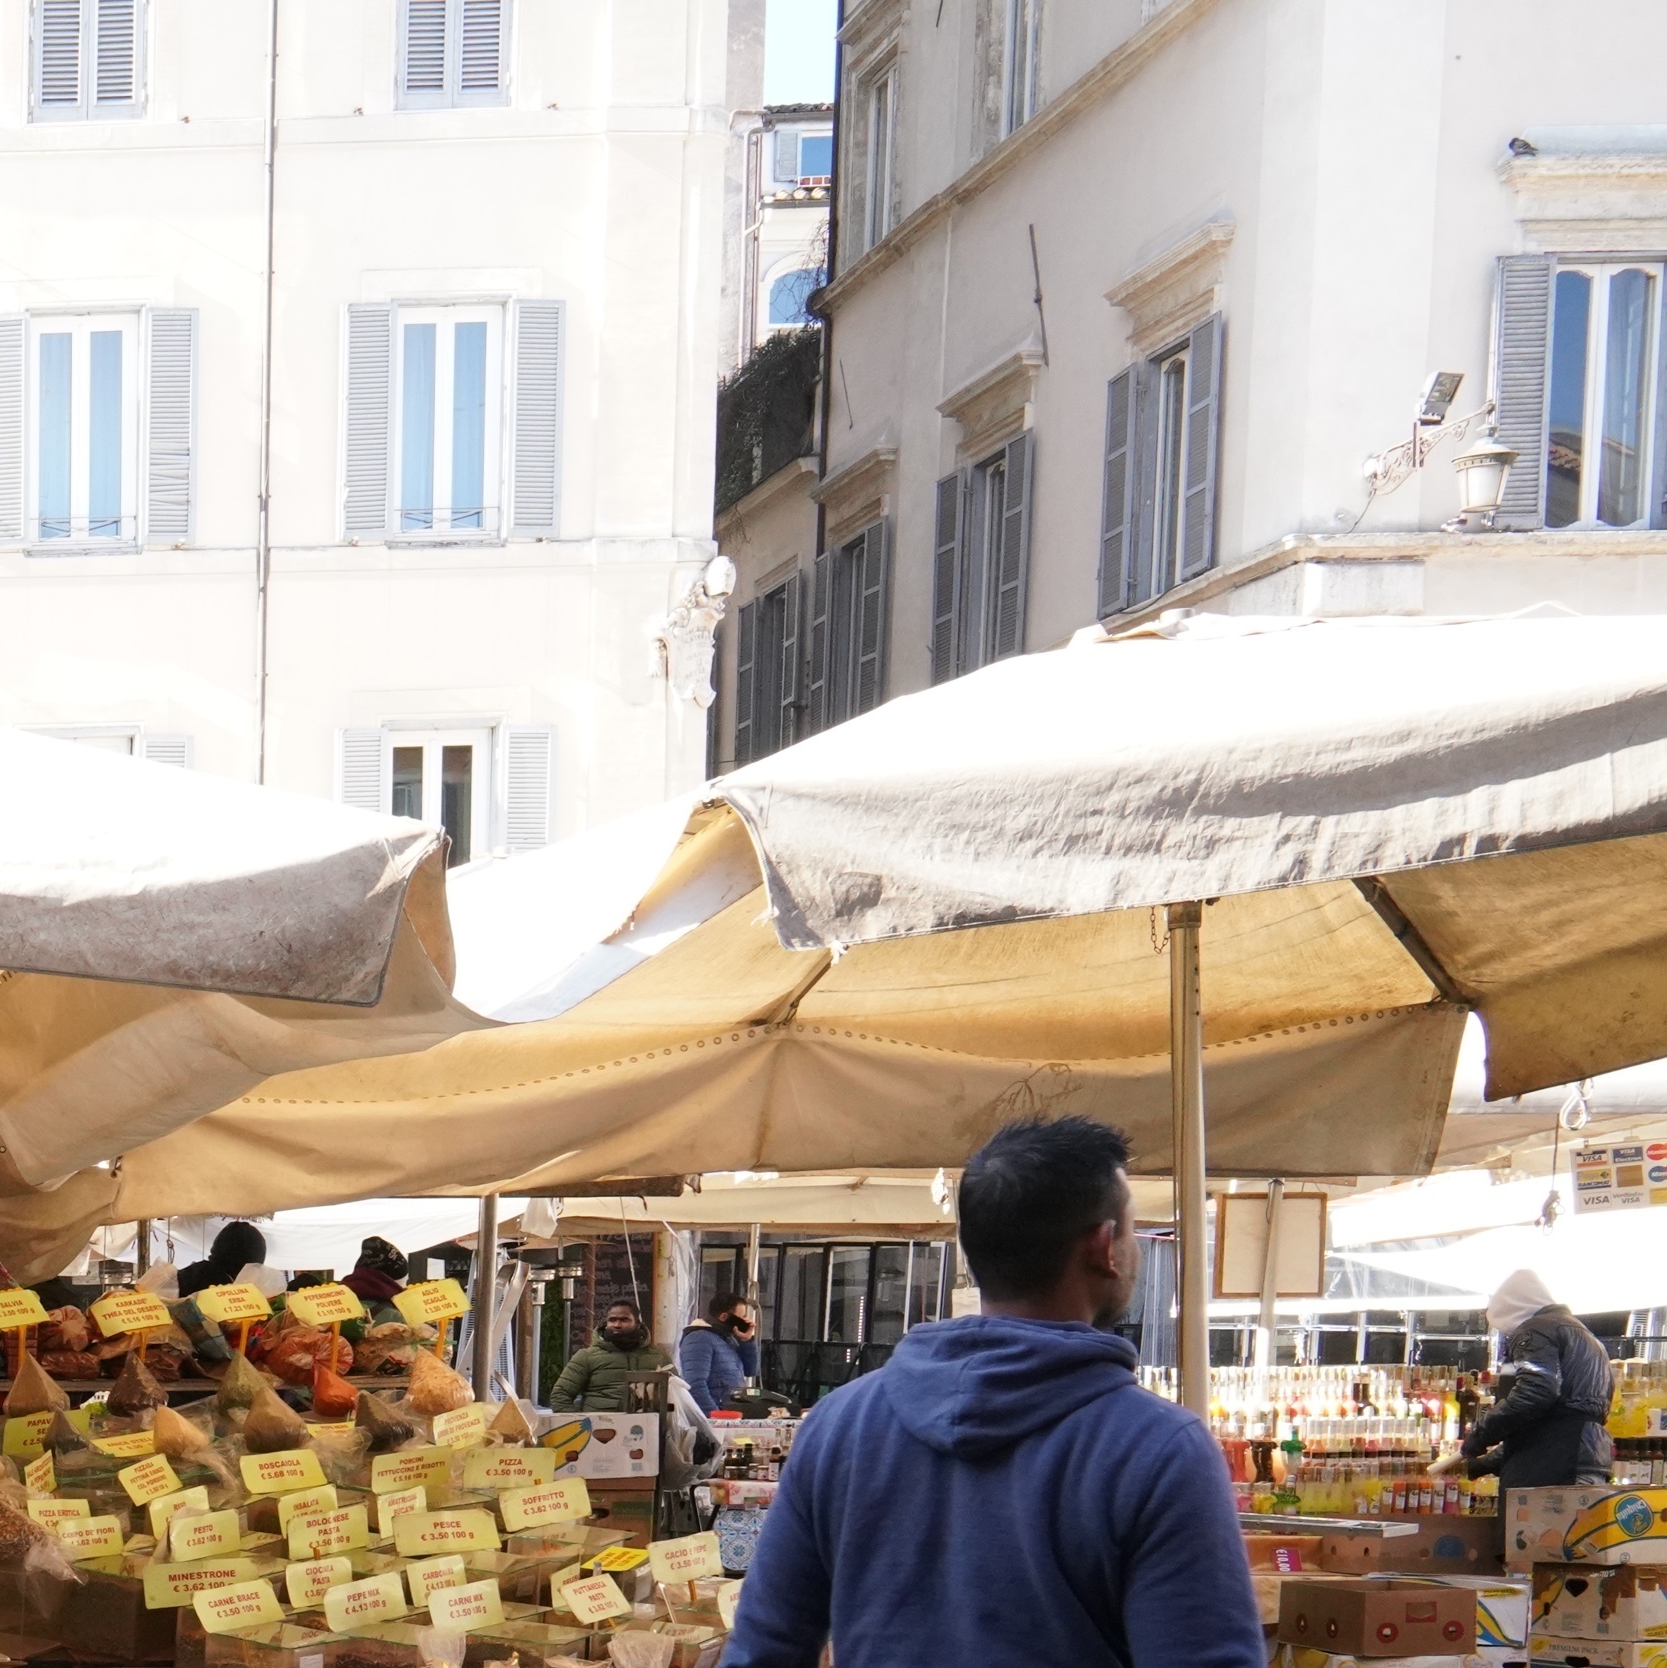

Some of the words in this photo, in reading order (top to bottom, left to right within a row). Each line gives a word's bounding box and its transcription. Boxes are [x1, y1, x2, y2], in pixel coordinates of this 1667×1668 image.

[1583, 1196, 1609, 1205] VISA
[216, 1288, 249, 1297] CIPOLLINA
[304, 1290, 345, 1301] PEPERONCINO
[422, 1288, 439, 1297] AGLIO
[0, 1300, 23, 1309] SALVIA
[316, 1300, 342, 1308] POLVERE
[423, 1295, 447, 1305] SCAGLIE
[442, 1302, 452, 1311] 100
[102, 1311, 123, 1320] THEA
[456, 1418, 480, 1433] PROVENZA
[258, 1458, 300, 1471] BOSCAIOLA
[399, 1456, 424, 1466] PORCINI
[499, 1458, 523, 1466] PIZZA
[377, 1466, 415, 1477] FETTUCCINE
[421, 1461, 445, 1470] RISOTTI
[493, 1468, 511, 1476] 3.50
[268, 1470, 285, 1480] 5.68
[286, 1469, 298, 1477] 100
[522, 1491, 564, 1506] SOFFRITTO
[57, 1509, 80, 1517] EROTICA
[531, 1504, 547, 1514] 3.62
[548, 1502, 562, 1512] 100
[193, 1524, 213, 1534] PESTO
[433, 1521, 461, 1529] PESCE
[62, 1530, 83, 1539] CAMPO
[97, 1527, 115, 1536] FIORI
[318, 1525, 340, 1537] PASTA
[429, 1532, 449, 1540] 3.50
[451, 1531, 466, 1539] 100
[91, 1537, 102, 1545] 100
[206, 1534, 217, 1543] 100
[316, 1538, 331, 1548] 3.50
[333, 1536, 344, 1544] 100
[665, 1549, 688, 1560] CACIO
[693, 1544, 707, 1555] PEPE
[676, 1560, 692, 1569] 3.50
[169, 1569, 236, 1582] MINESTRONE
[183, 1583, 205, 1592] 3.62
[209, 1581, 226, 1589] 100
[312, 1577, 330, 1586] PASTA
[572, 1581, 606, 1595] PUTTANESCA
[208, 1596, 236, 1608] CARNE
[237, 1591, 260, 1602] BRACE
[347, 1591, 367, 1603] PEPE
[368, 1588, 381, 1599] MIX
[588, 1594, 605, 1602] PASTA
[352, 1603, 368, 1614] 4.13
[369, 1600, 381, 1609] 100
[449, 1597, 473, 1607] CARNE
[223, 1607, 240, 1617] 3.50
[242, 1605, 254, 1614] 100
[456, 1608, 472, 1617] 3.50
[473, 1606, 481, 1614] 100
